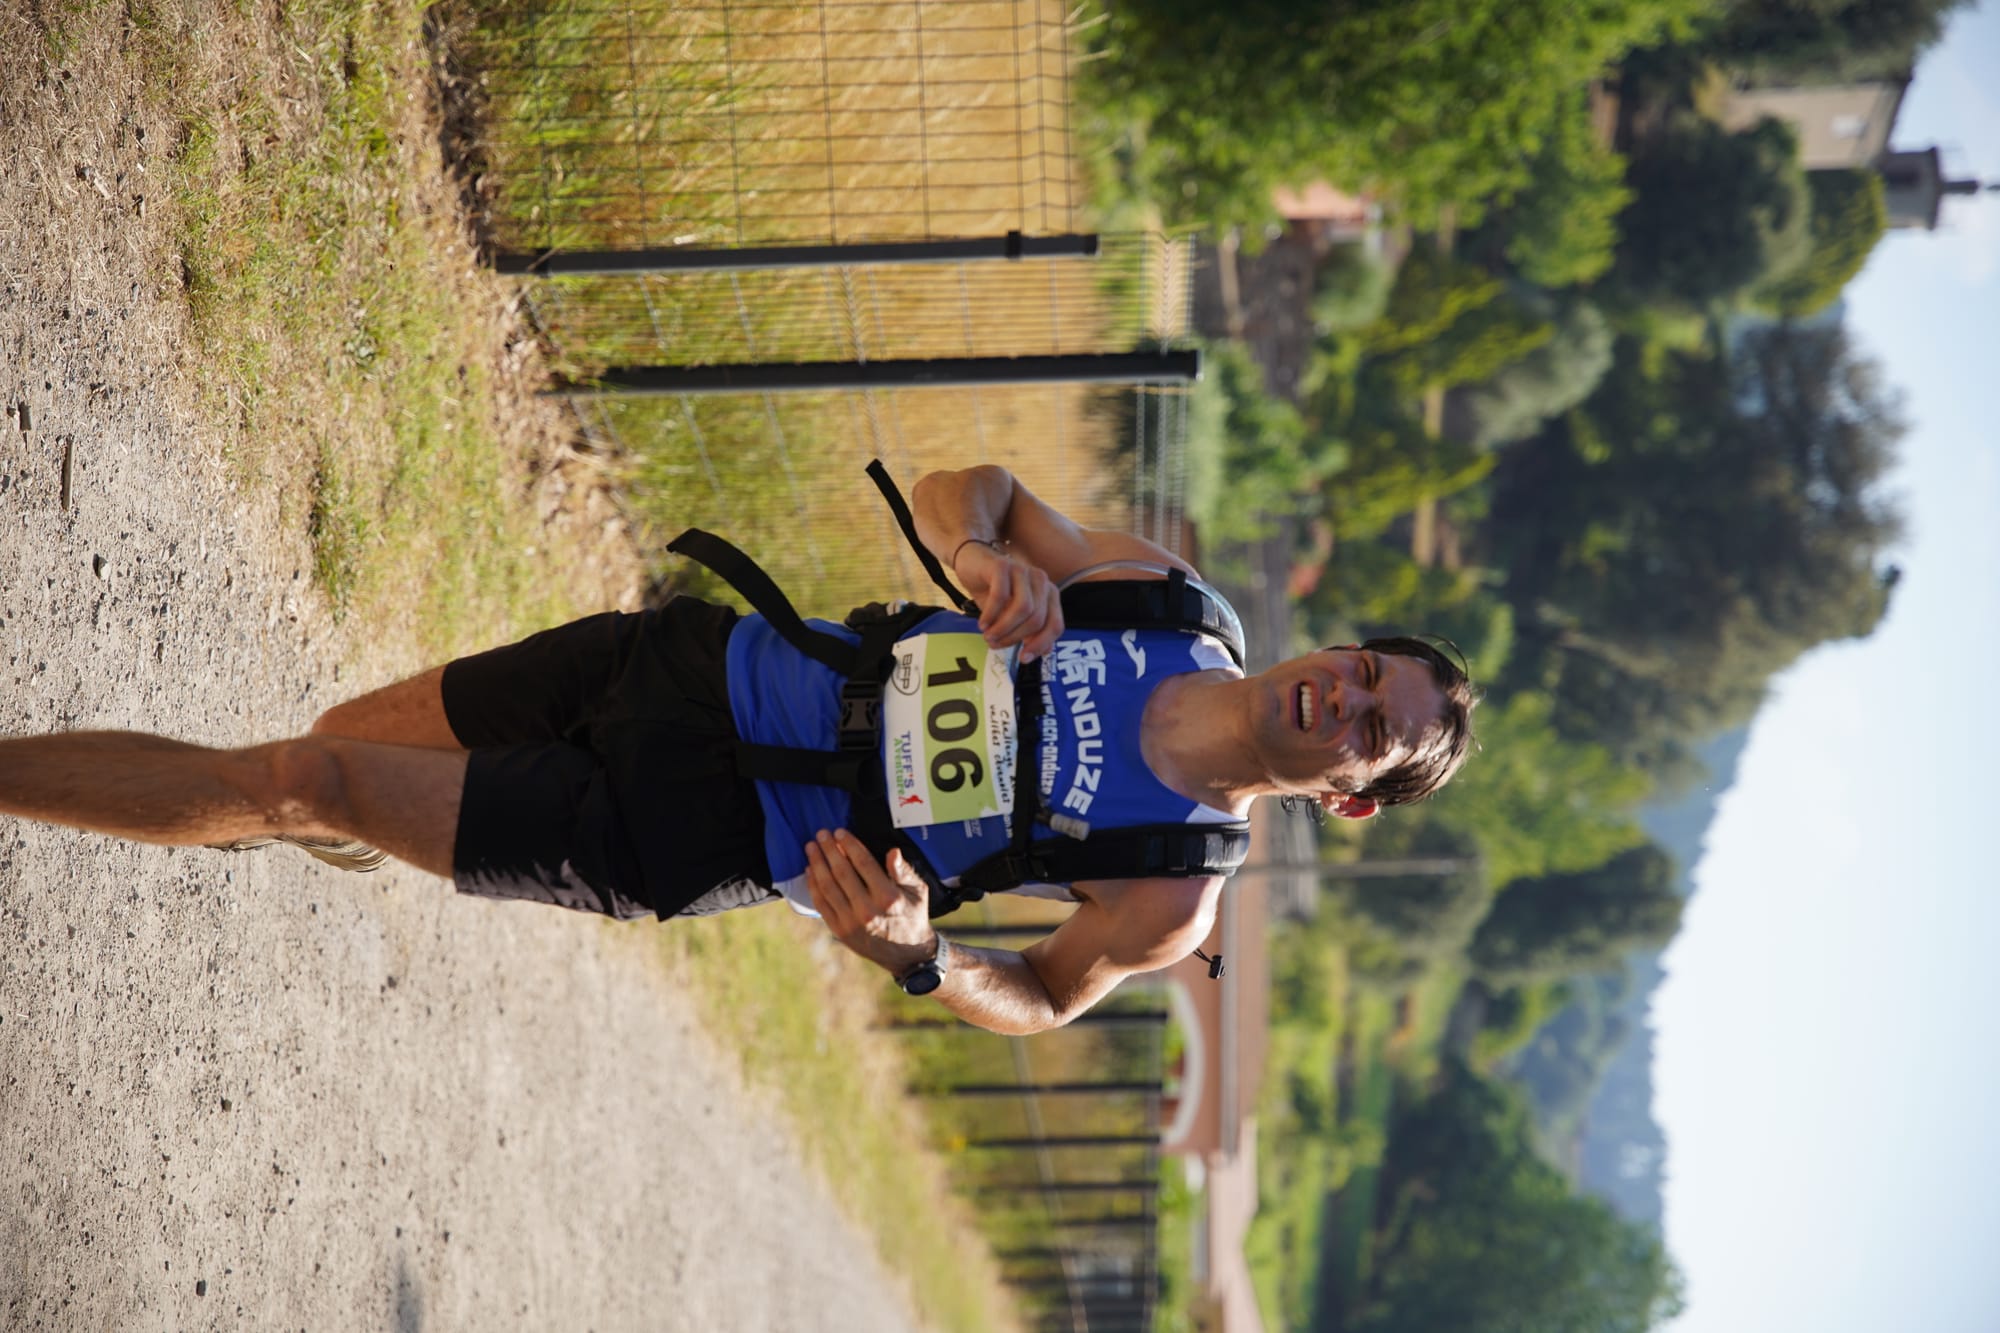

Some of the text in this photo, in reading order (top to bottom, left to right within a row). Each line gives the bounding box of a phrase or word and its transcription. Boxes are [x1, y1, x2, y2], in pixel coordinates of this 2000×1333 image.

[900, 653, 913, 689] BFP
[927, 657, 984, 793] 106
[1001, 710, 1014, 768] Challenge
[893, 738, 906, 795] Aventure
[901, 731, 914, 789] TUFF'S
